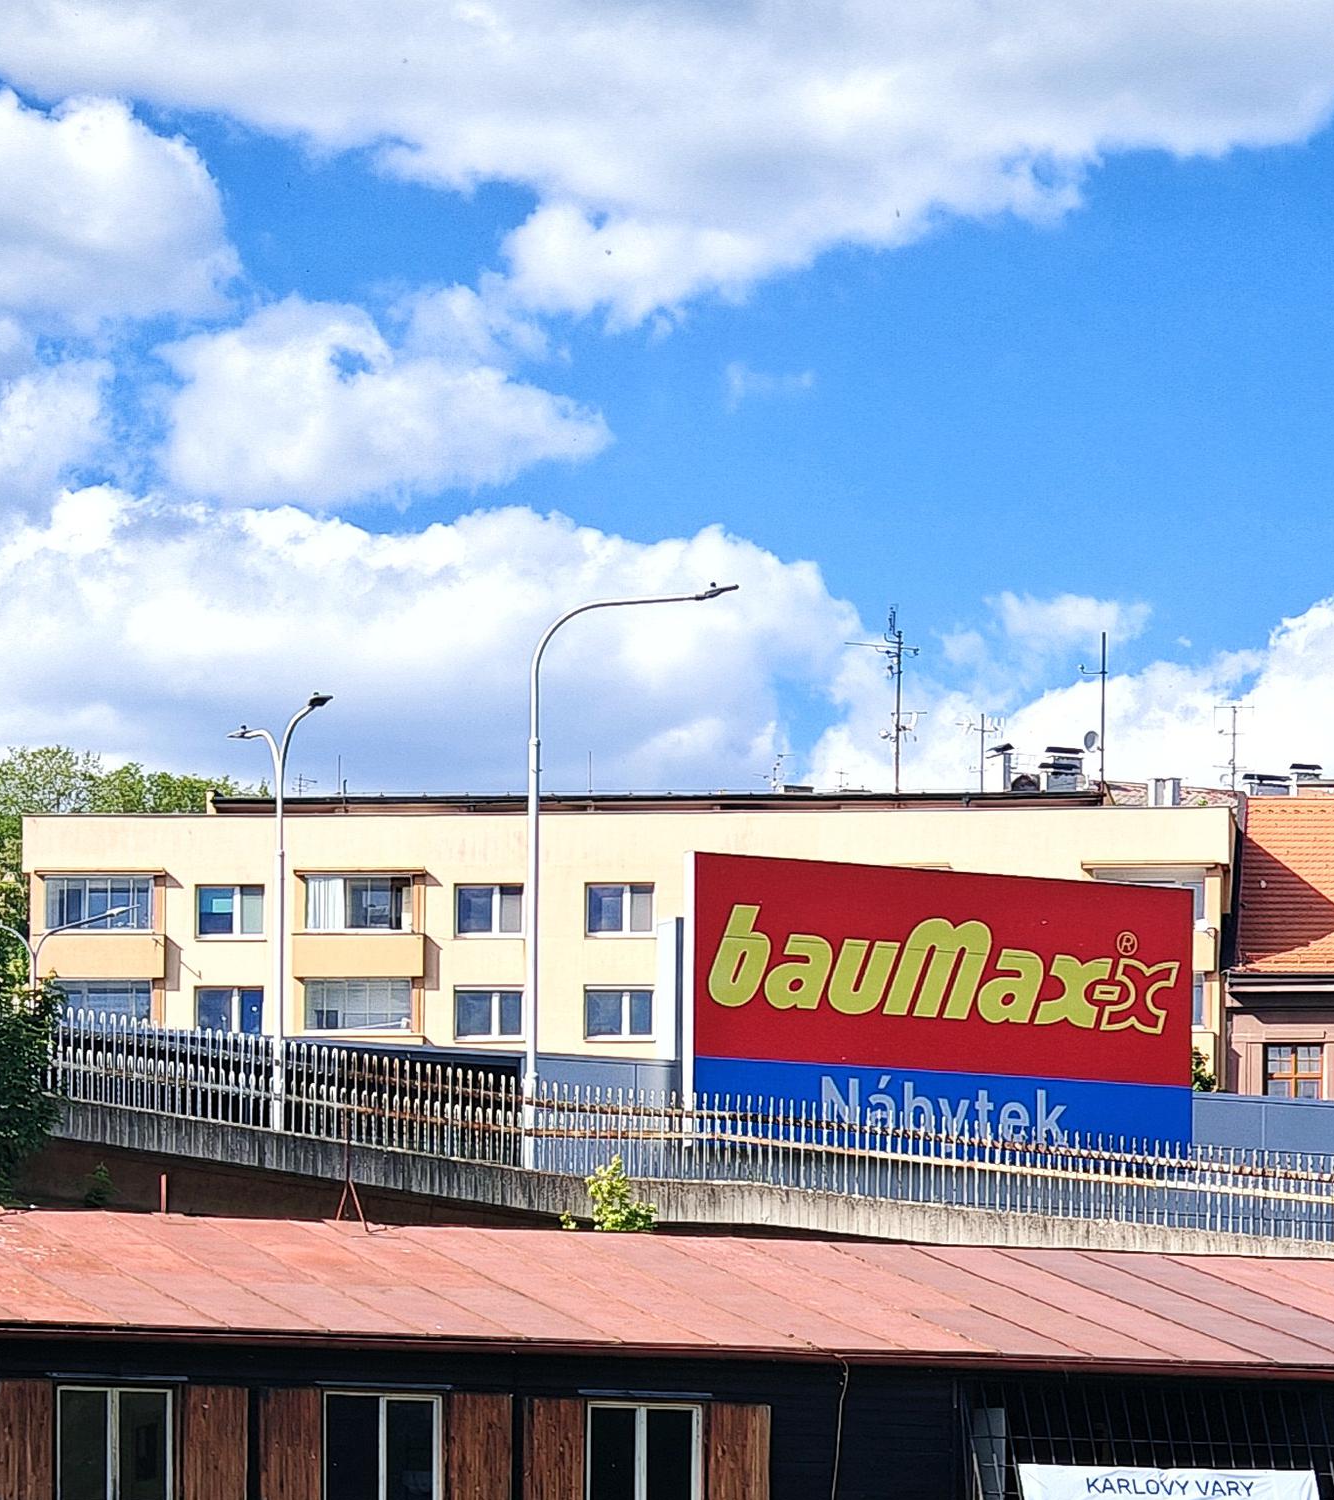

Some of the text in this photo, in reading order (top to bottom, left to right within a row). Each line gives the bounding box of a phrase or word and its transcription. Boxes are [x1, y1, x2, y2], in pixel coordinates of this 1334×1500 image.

[820, 1074, 1067, 1145] Nábytek
[1086, 1477, 1254, 1497] KARLOVY VARY
